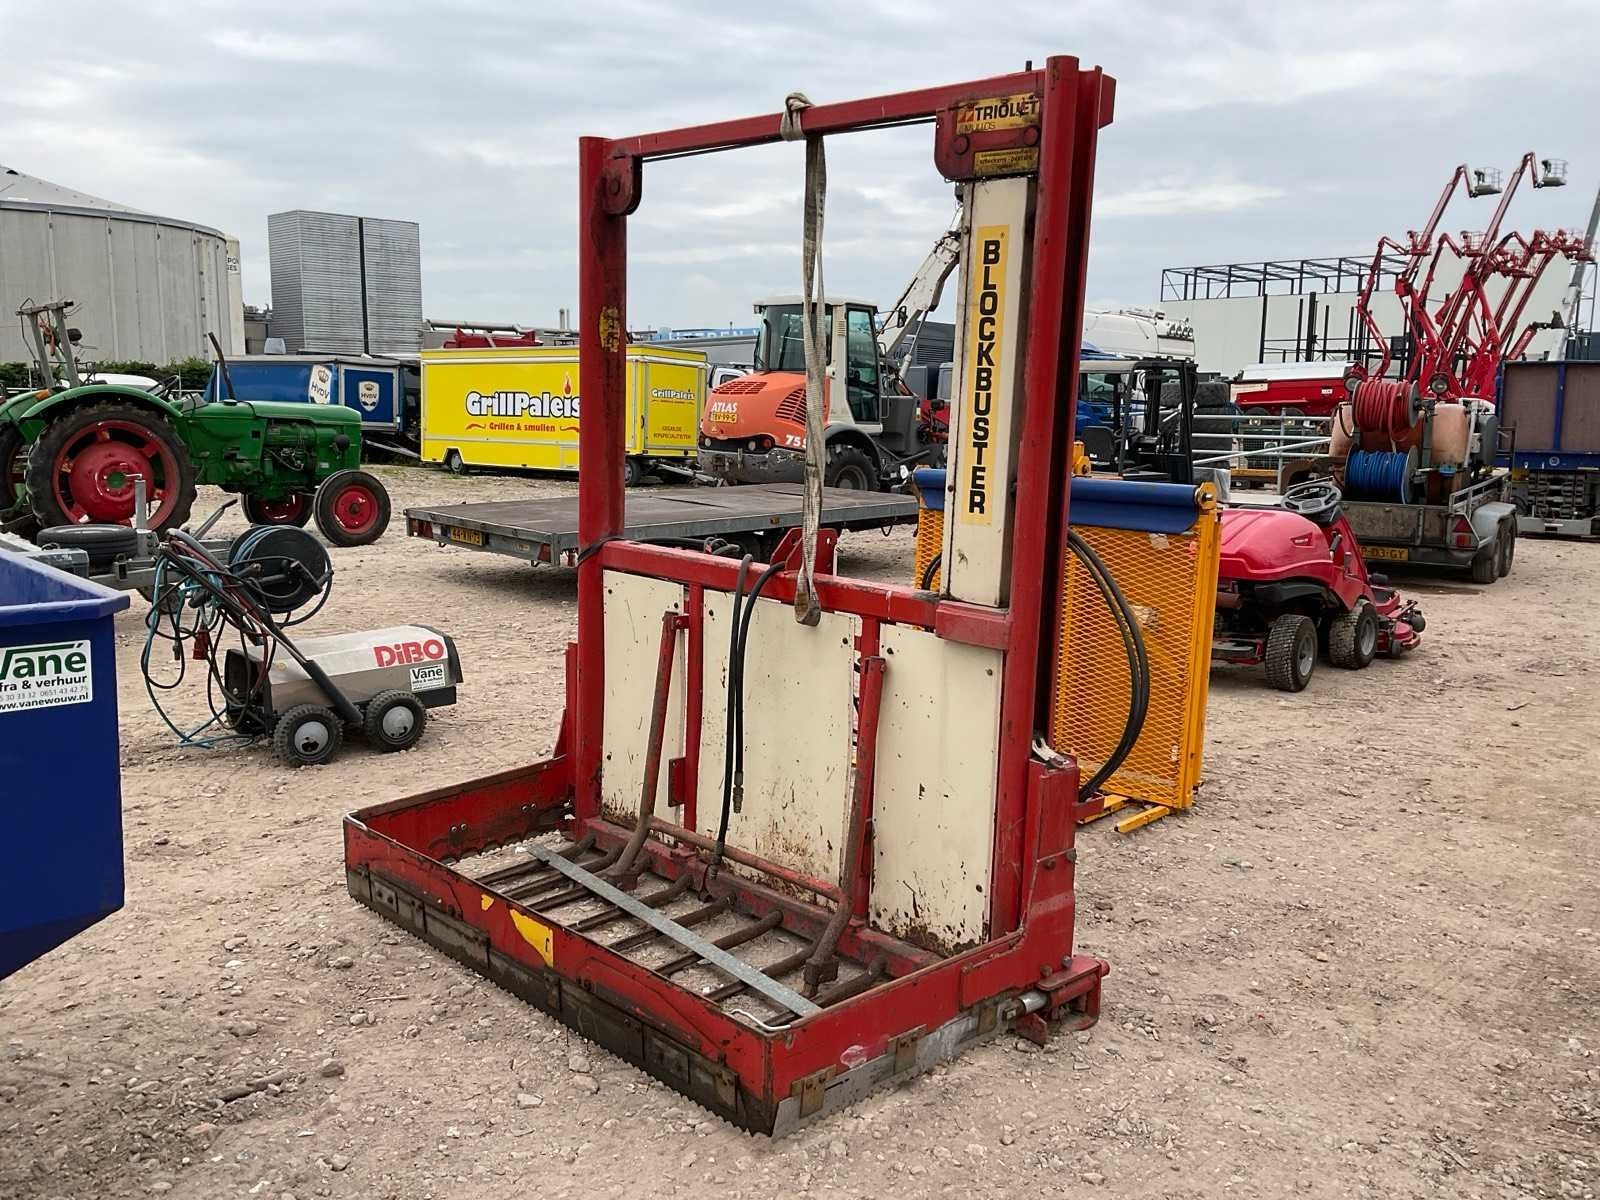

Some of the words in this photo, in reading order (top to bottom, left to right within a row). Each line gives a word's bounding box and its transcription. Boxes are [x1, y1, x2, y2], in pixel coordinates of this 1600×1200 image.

[968, 239, 1001, 515] BLOCKBUSTER
[465, 391, 580, 419] GrillPaleis
[711, 402, 738, 413] ATLAS
[489, 422, 515, 431] Grillen
[524, 423, 556, 432] smullen
[374, 639, 444, 668] DiBO
[0, 681, 18, 692] fra
[22, 680, 31, 690] &
[36, 676, 88, 688] verhuur
[0, 692, 89, 710] ww.vanewouw.nl
